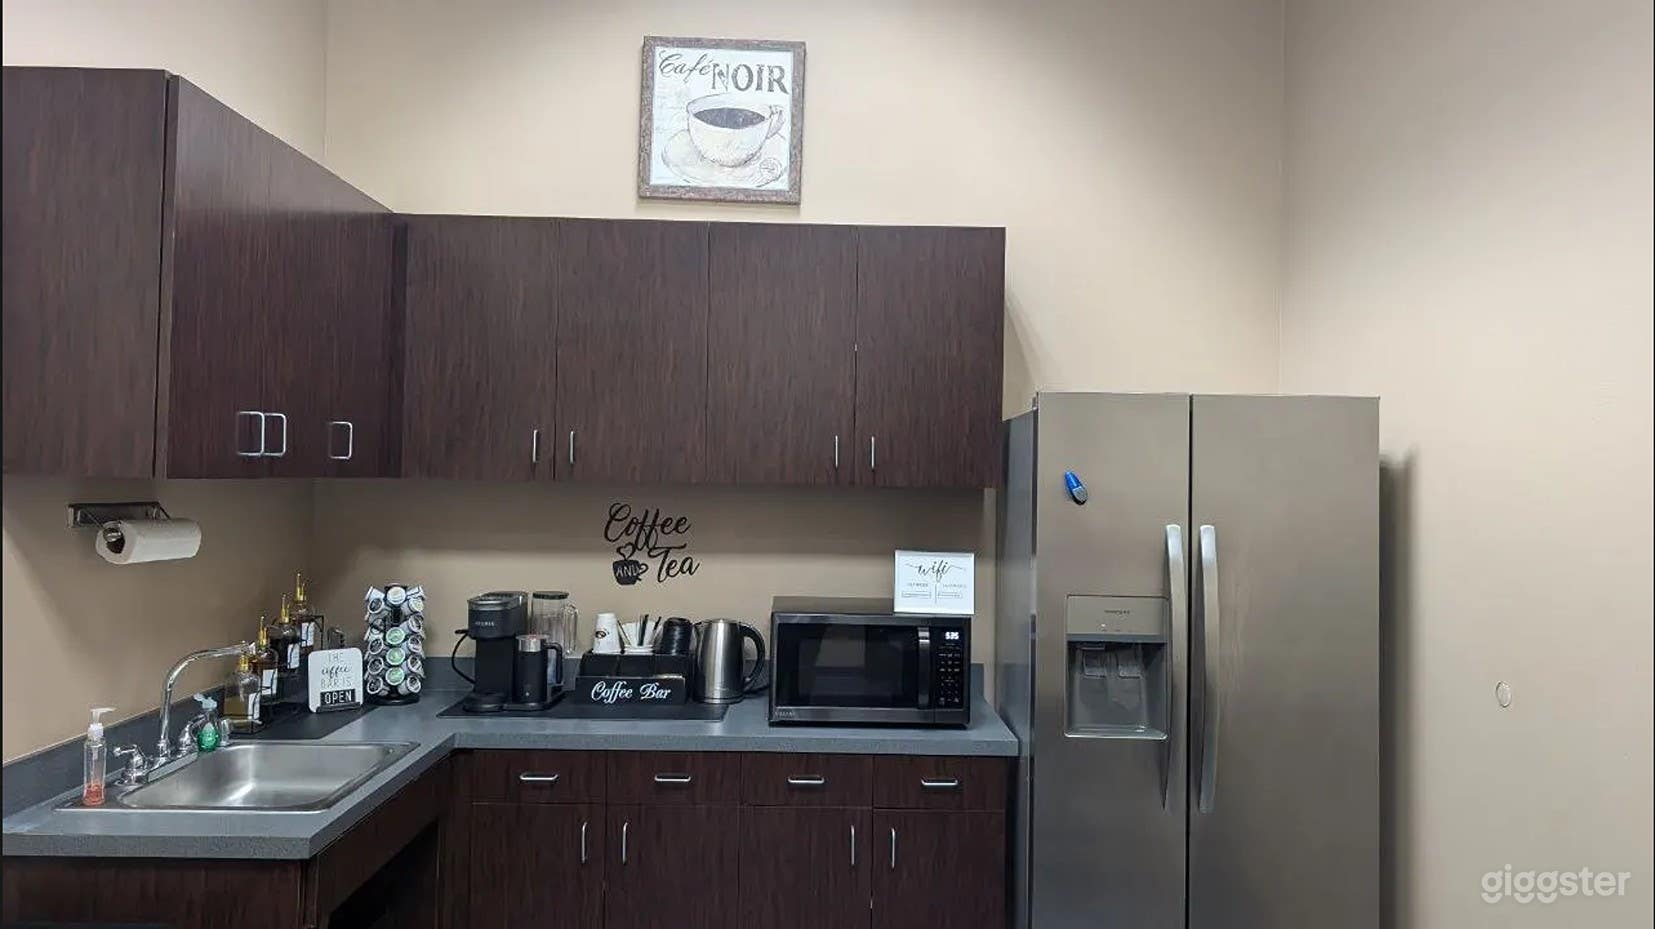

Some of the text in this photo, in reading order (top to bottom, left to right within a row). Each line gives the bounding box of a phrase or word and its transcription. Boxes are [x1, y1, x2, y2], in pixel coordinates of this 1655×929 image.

[658, 50, 790, 95] Café NOIR
[604, 502, 692, 551] Coffee
[647, 543, 700, 583] Tea
[907, 559, 963, 583] wifi
[324, 690, 352, 704] OPEN
[591, 680, 672, 704] Coffee Bar
